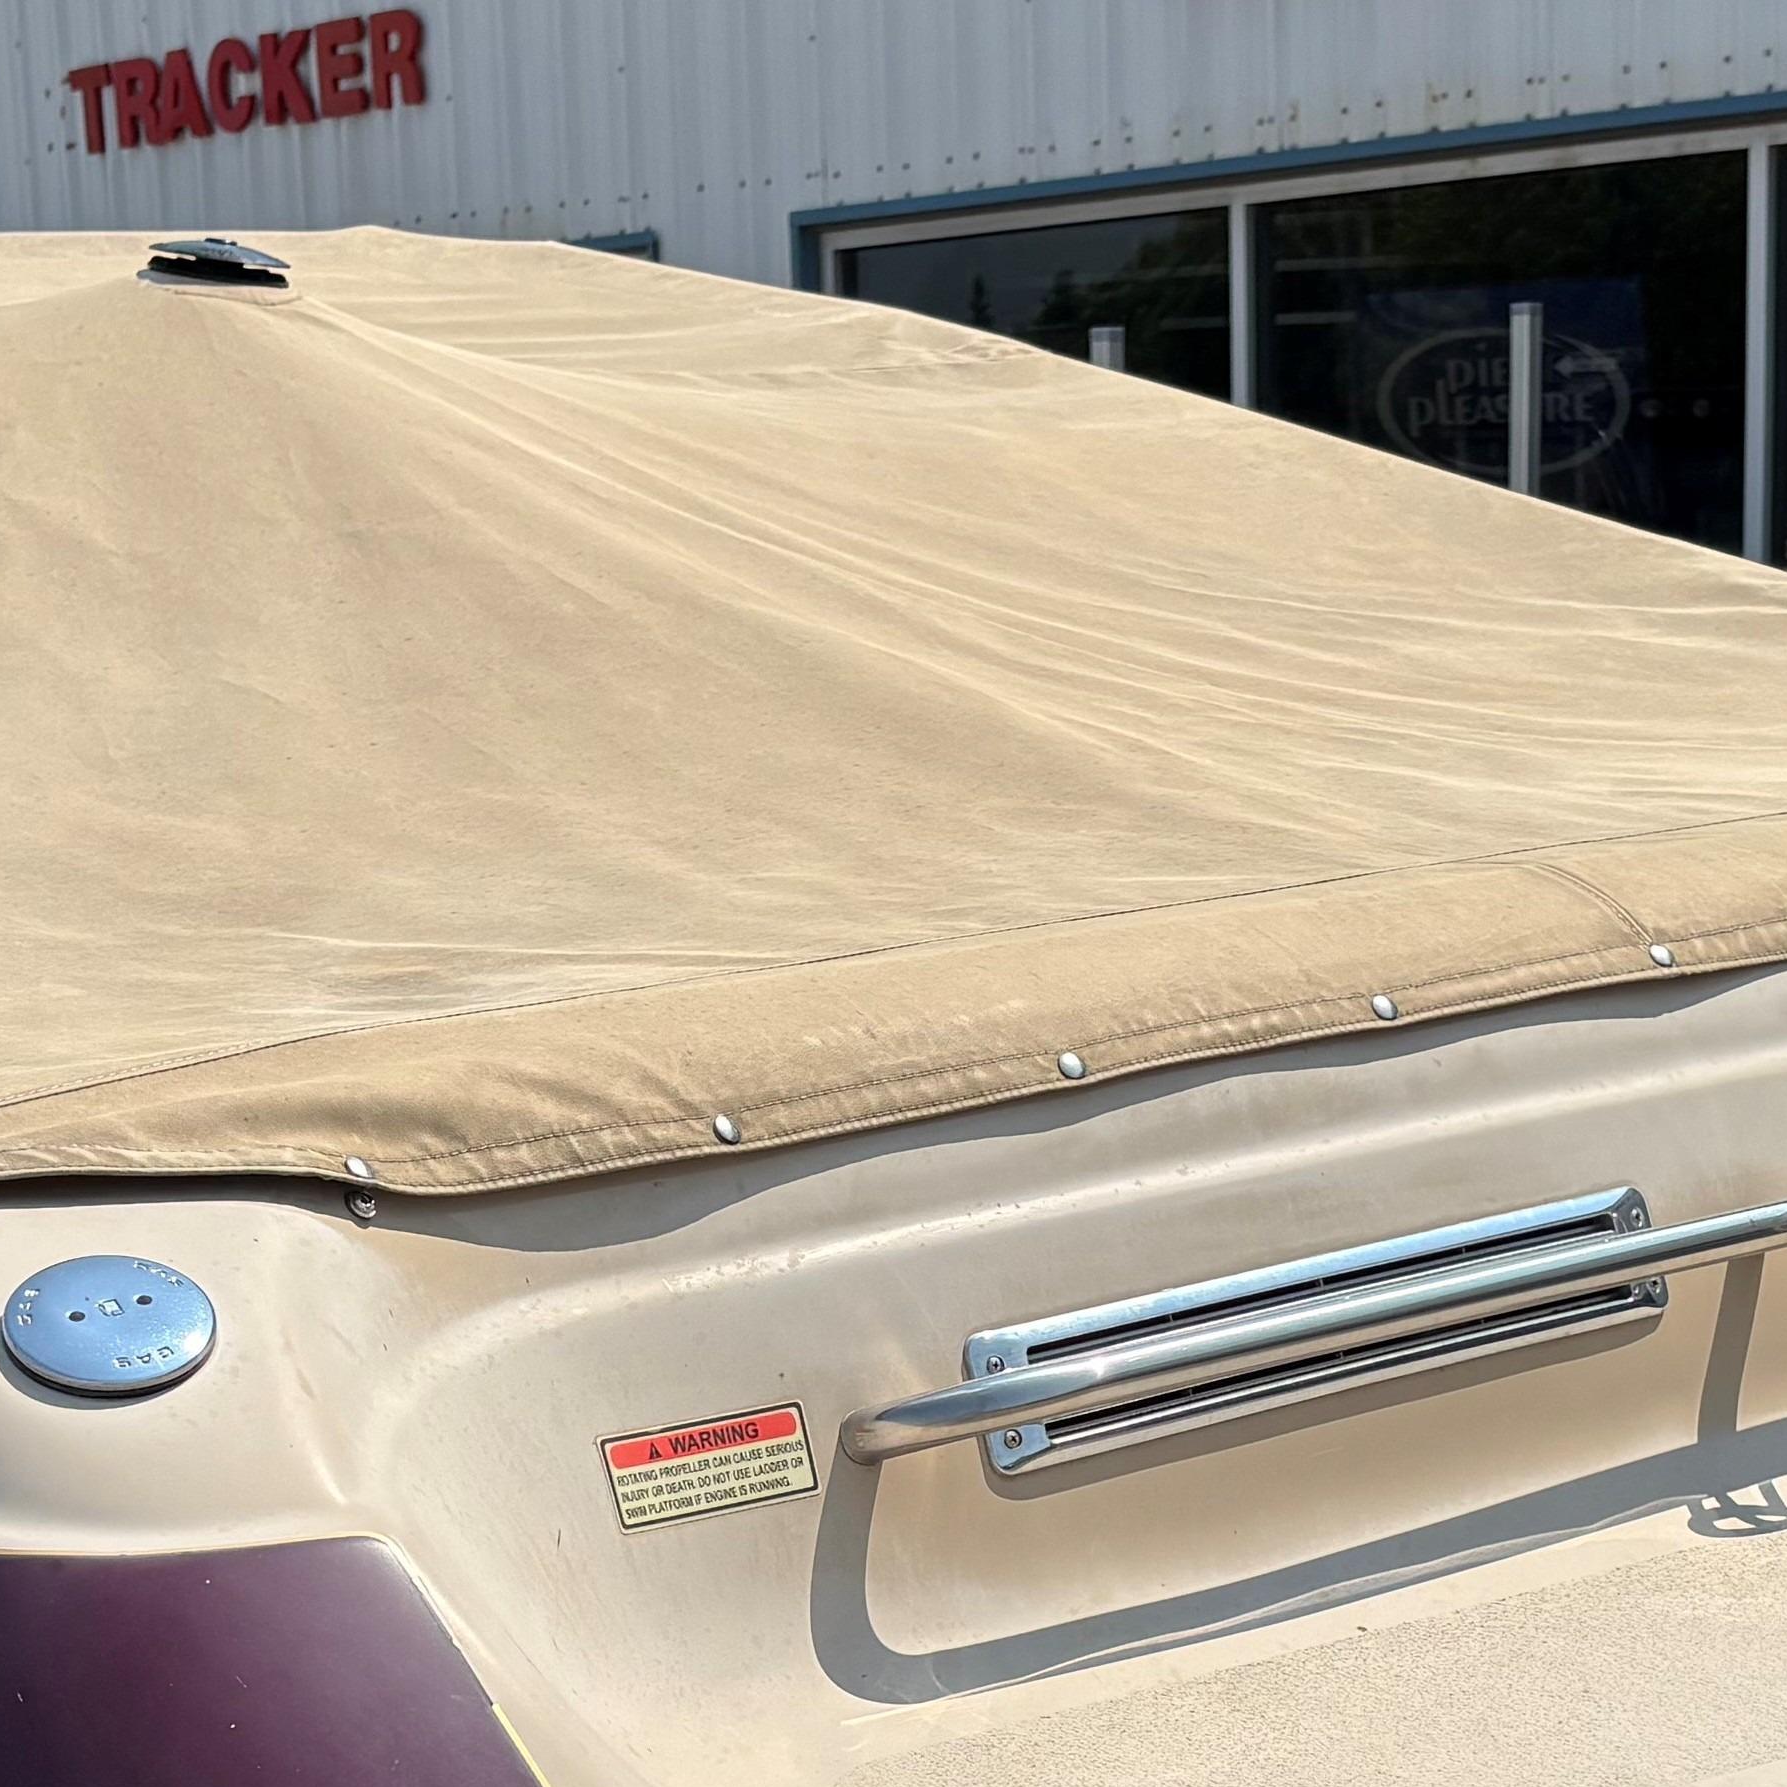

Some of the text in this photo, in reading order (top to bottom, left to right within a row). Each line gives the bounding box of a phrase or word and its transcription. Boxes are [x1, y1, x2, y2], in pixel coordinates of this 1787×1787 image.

[68, 8, 427, 156] TRACKER
[668, 1422, 759, 1455] WARNING
[616, 1440, 804, 1487] ROTATING PROPELLER CAN CAUSE SERIOUS
[621, 1488, 650, 1503] INJURY
[651, 1484, 665, 1497] OR
[697, 1475, 711, 1488] DO
[712, 1471, 731, 1485] NOT
[733, 1466, 752, 1481] USE
[753, 1459, 790, 1477] LADDER
[790, 1456, 804, 1469] OR
[625, 1505, 648, 1519] SWIM
[647, 1495, 694, 1514] PLATFORM
[694, 1493, 703, 1505] IF
[704, 1486, 738, 1504] ENGINE
[738, 1484, 748, 1496] IS
